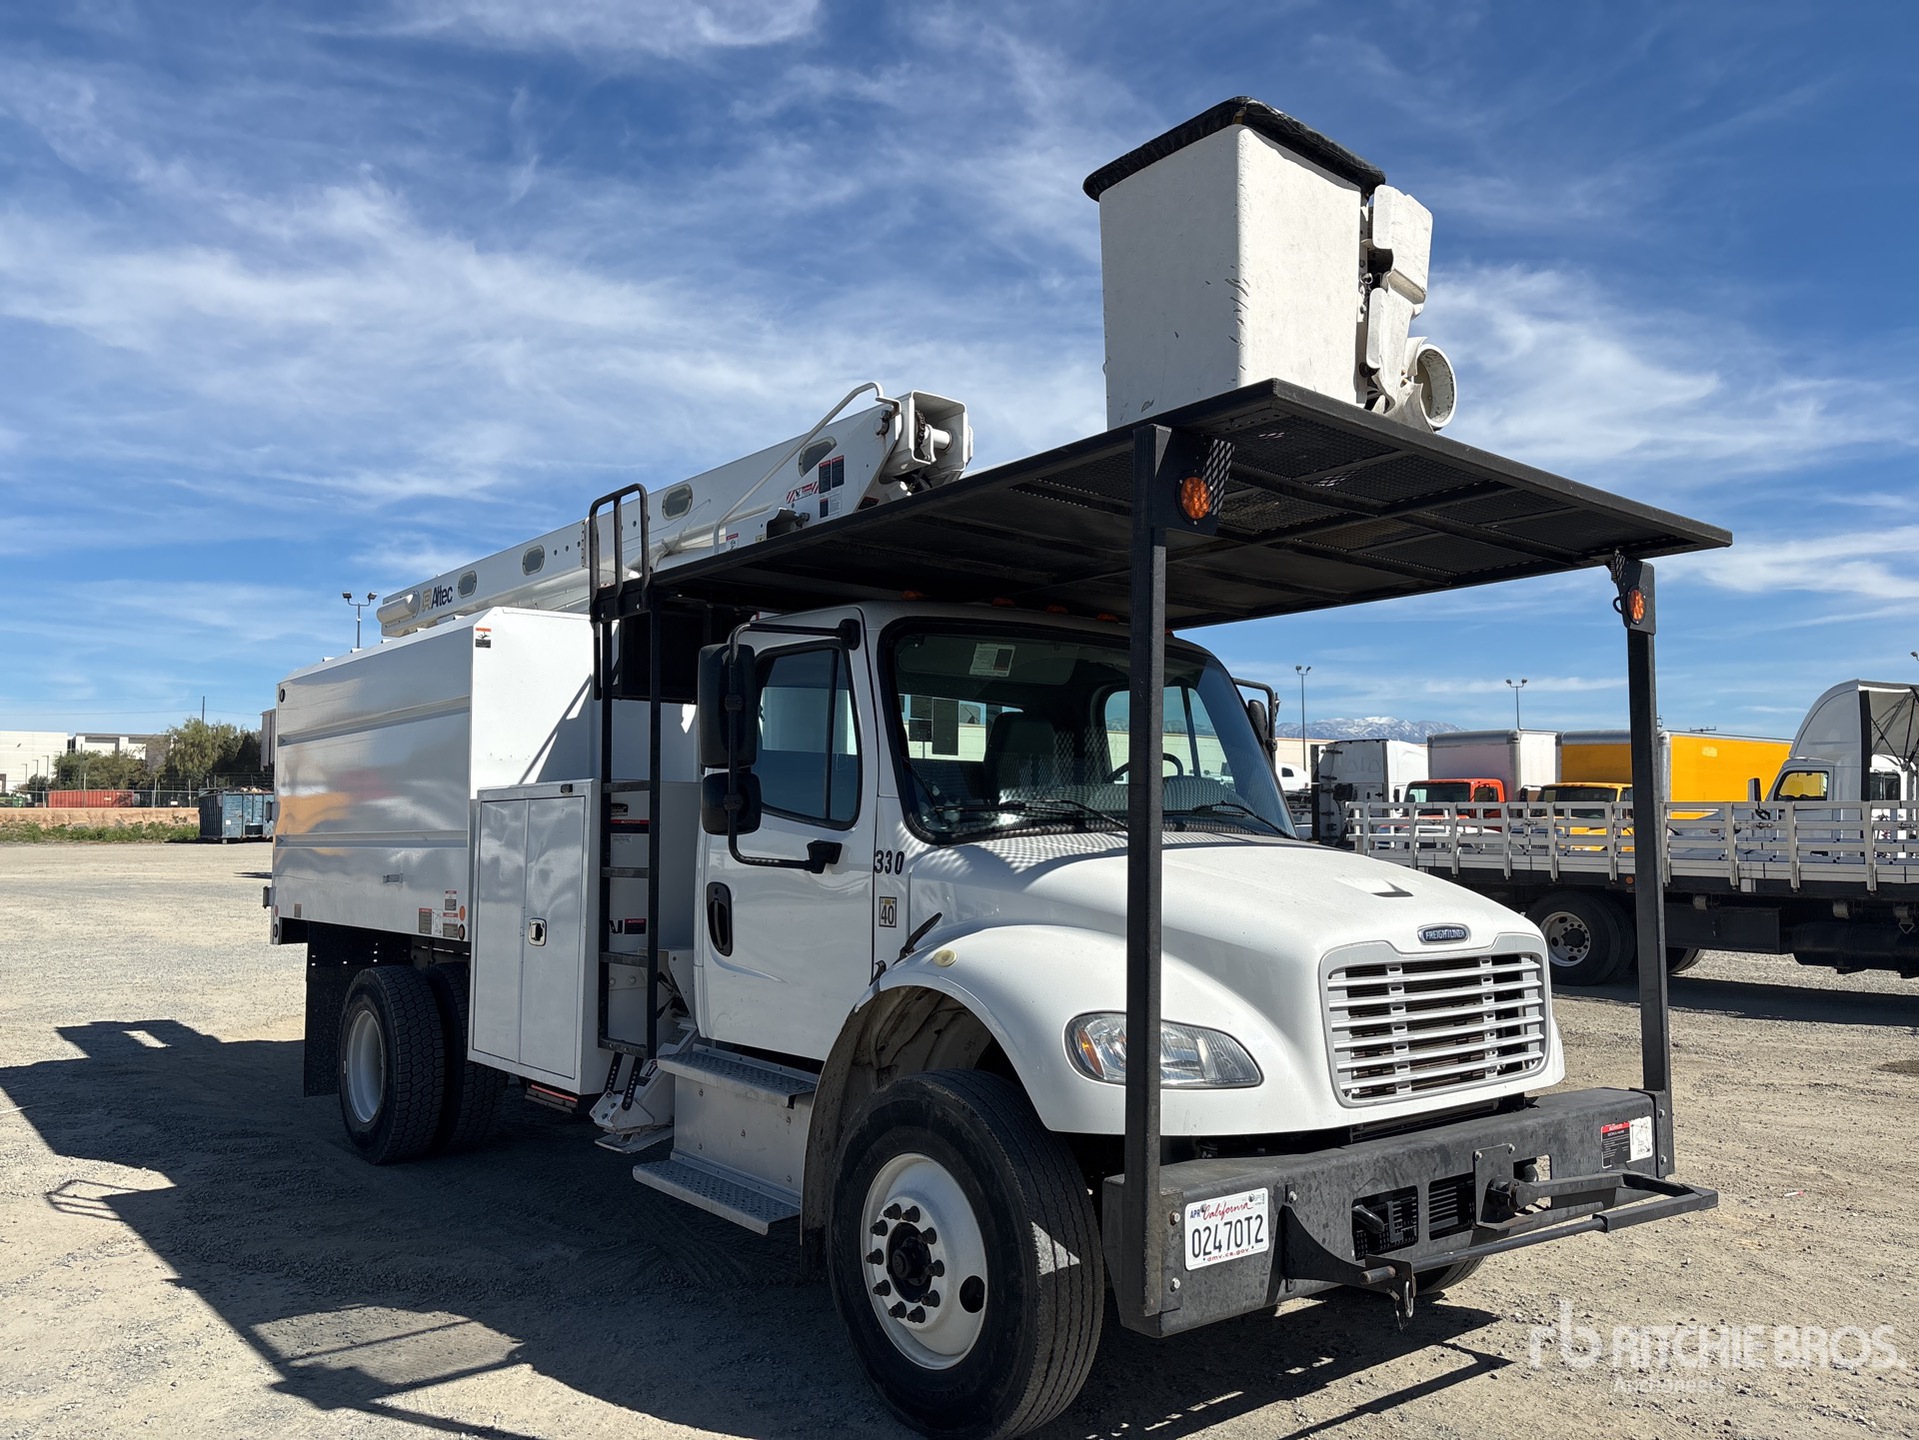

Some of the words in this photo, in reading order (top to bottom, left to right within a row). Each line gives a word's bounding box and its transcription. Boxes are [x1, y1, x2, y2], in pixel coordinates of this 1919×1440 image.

[431, 585, 453, 609] Altec
[873, 849, 905, 875] 330
[881, 904, 895, 925] 40
[1425, 928, 1465, 940] FREIGHTLINER
[1190, 1208, 1201, 1219] APR
[1202, 1200, 1253, 1220] California
[1192, 1214, 1264, 1258] 02470T2
[1207, 1247, 1249, 1262] dmv.ca.gov
